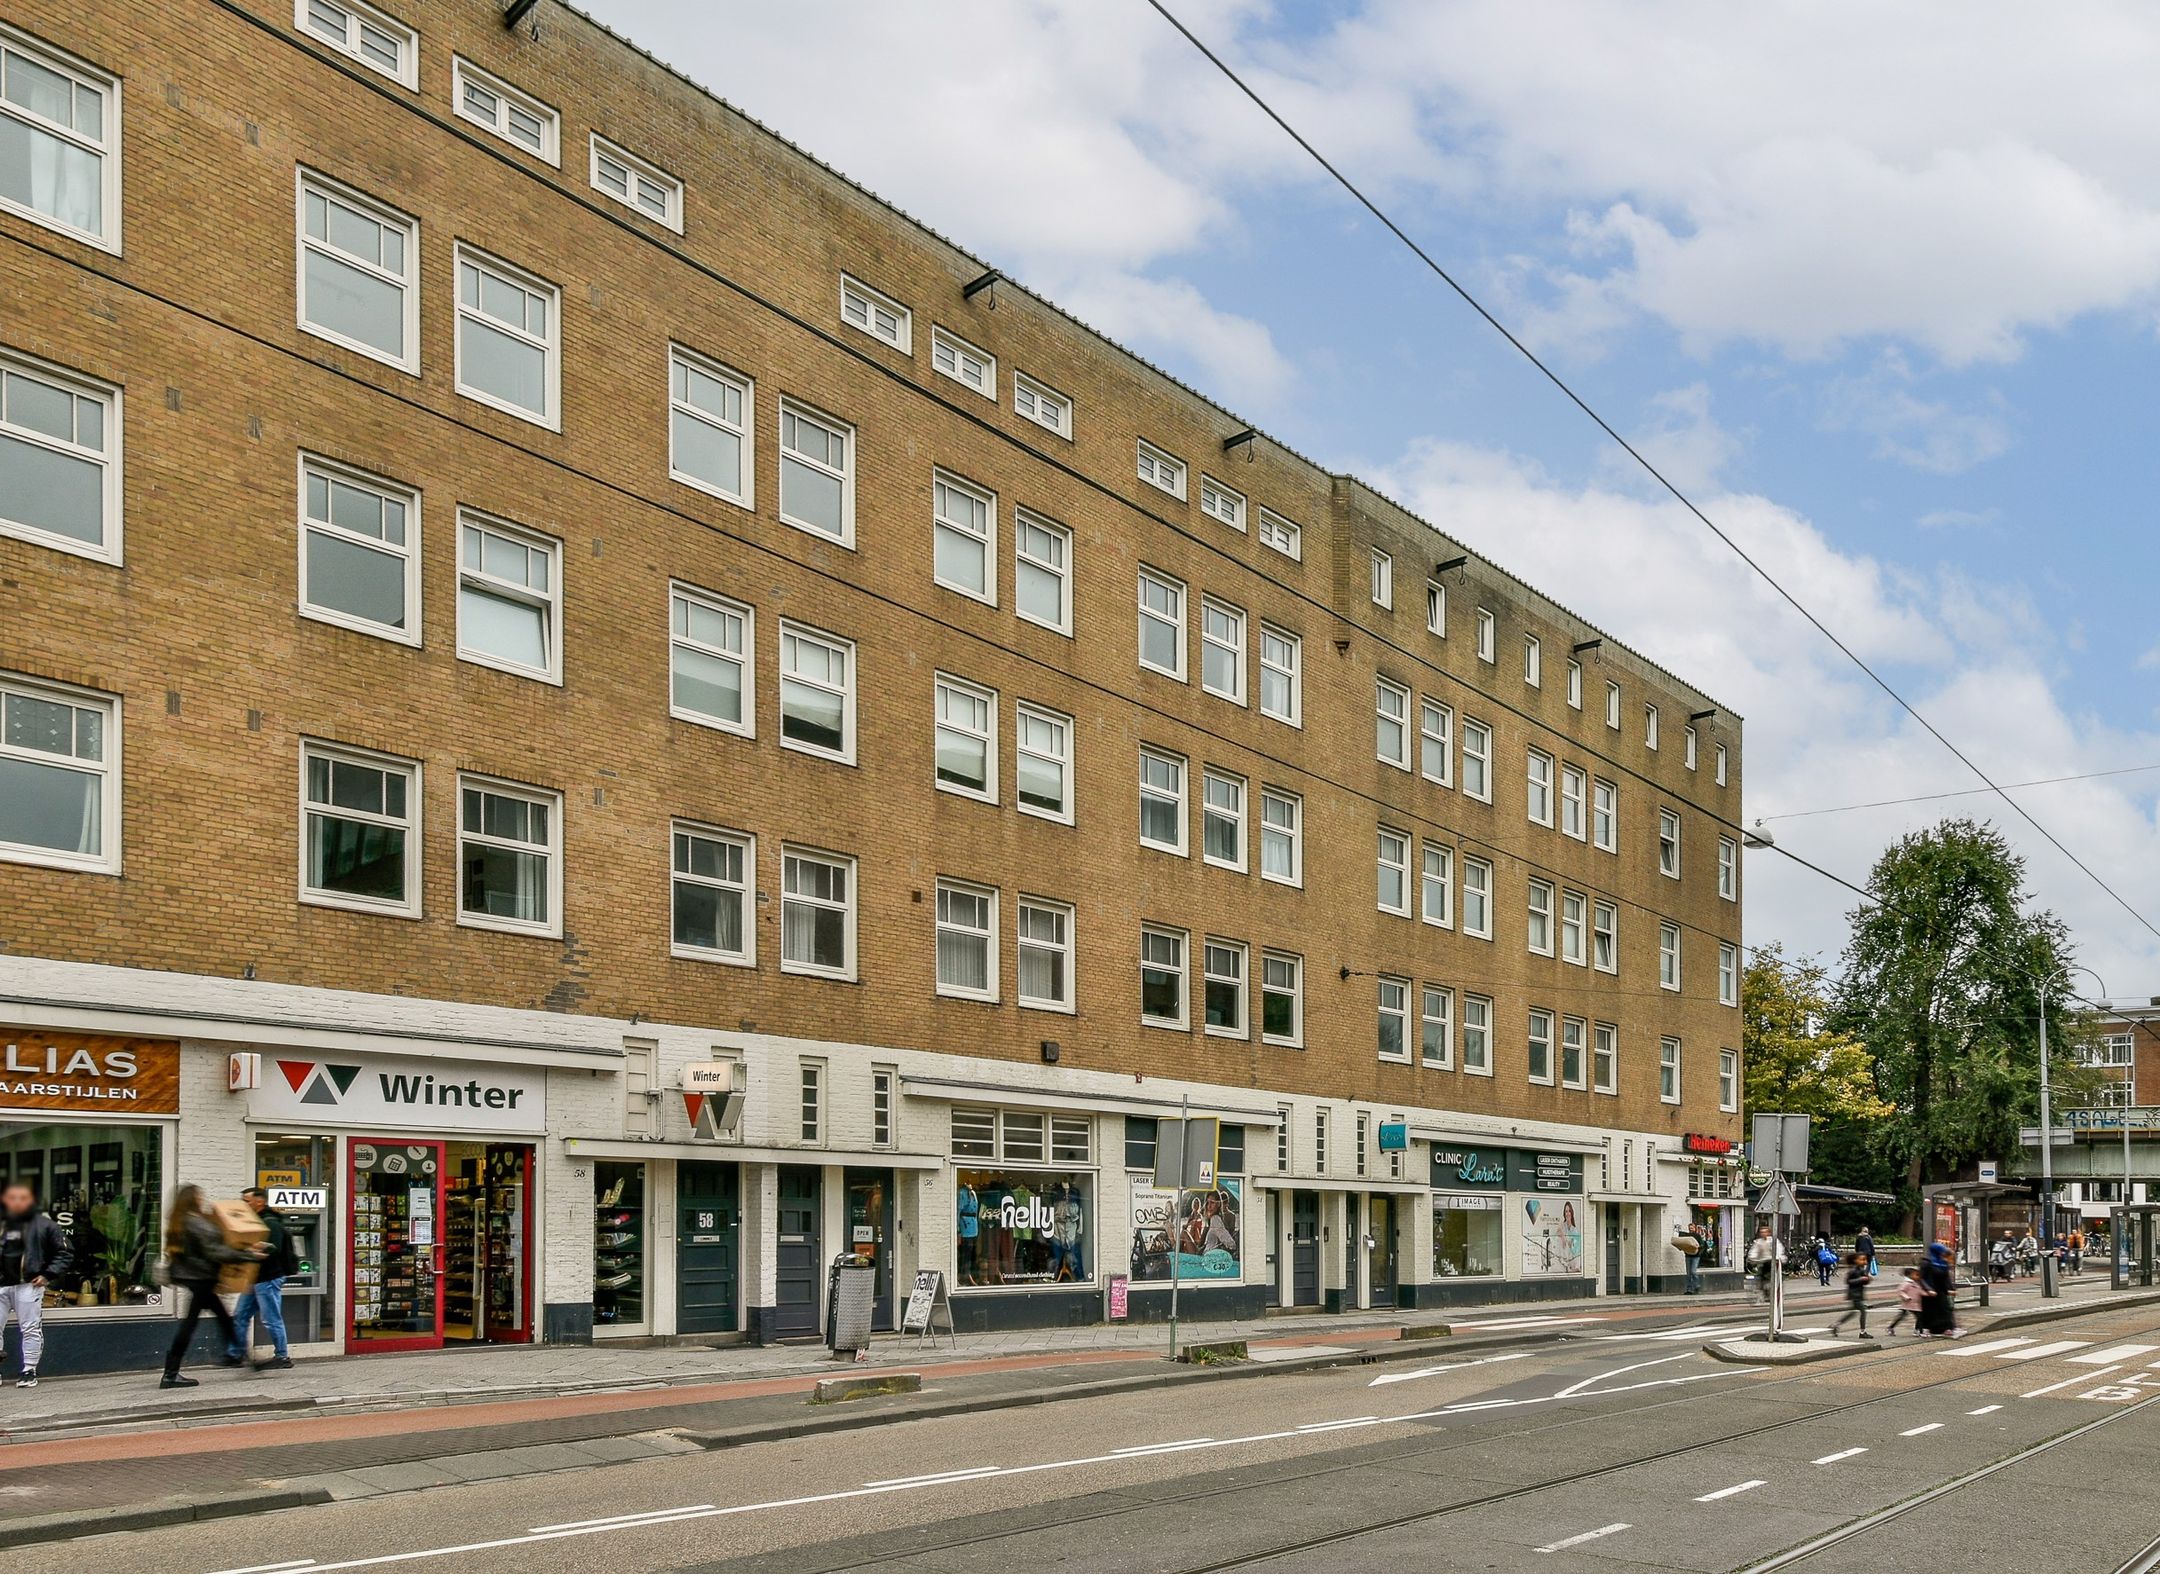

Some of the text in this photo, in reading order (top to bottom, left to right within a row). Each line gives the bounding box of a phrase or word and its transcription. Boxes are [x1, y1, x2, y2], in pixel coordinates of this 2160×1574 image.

[692, 1070, 721, 1082] Winter
[379, 1073, 524, 1109] Winter
[1435, 1152, 1462, 1165] CLINIC
[266, 1175, 293, 1183] ATM
[574, 1169, 586, 1178] 58
[274, 1192, 320, 1205] ATM
[698, 1213, 714, 1228] 58
